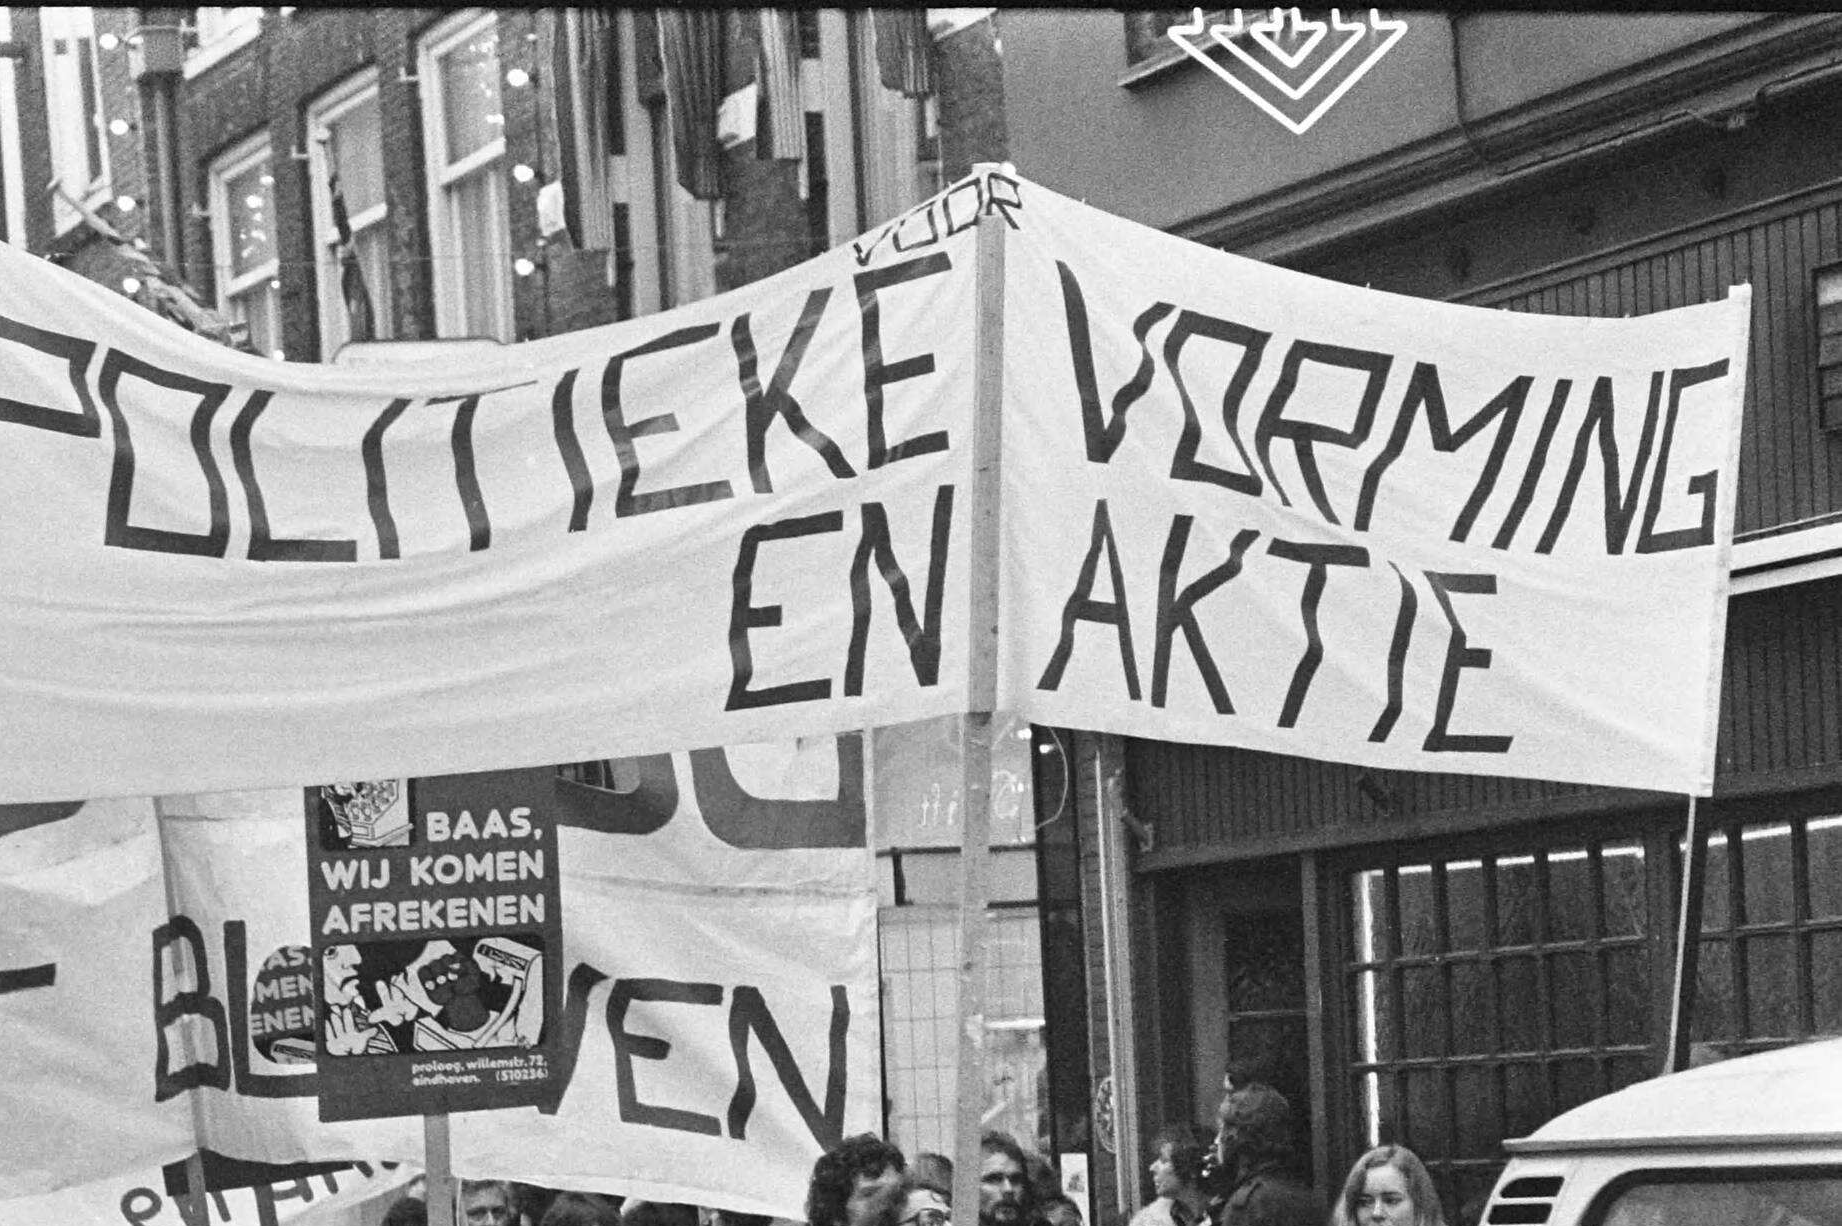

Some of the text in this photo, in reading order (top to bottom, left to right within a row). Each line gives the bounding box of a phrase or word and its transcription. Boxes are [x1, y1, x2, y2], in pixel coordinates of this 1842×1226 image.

[853, 172, 1022, 266] VOOR
[1055, 260, 1729, 555] VORMING
[725, 484, 1513, 753] EN AKTIE
[425, 806, 543, 842] BAAS,
[320, 849, 545, 891] WIJ KOMEN
[321, 893, 546, 935] AFREKENEN
